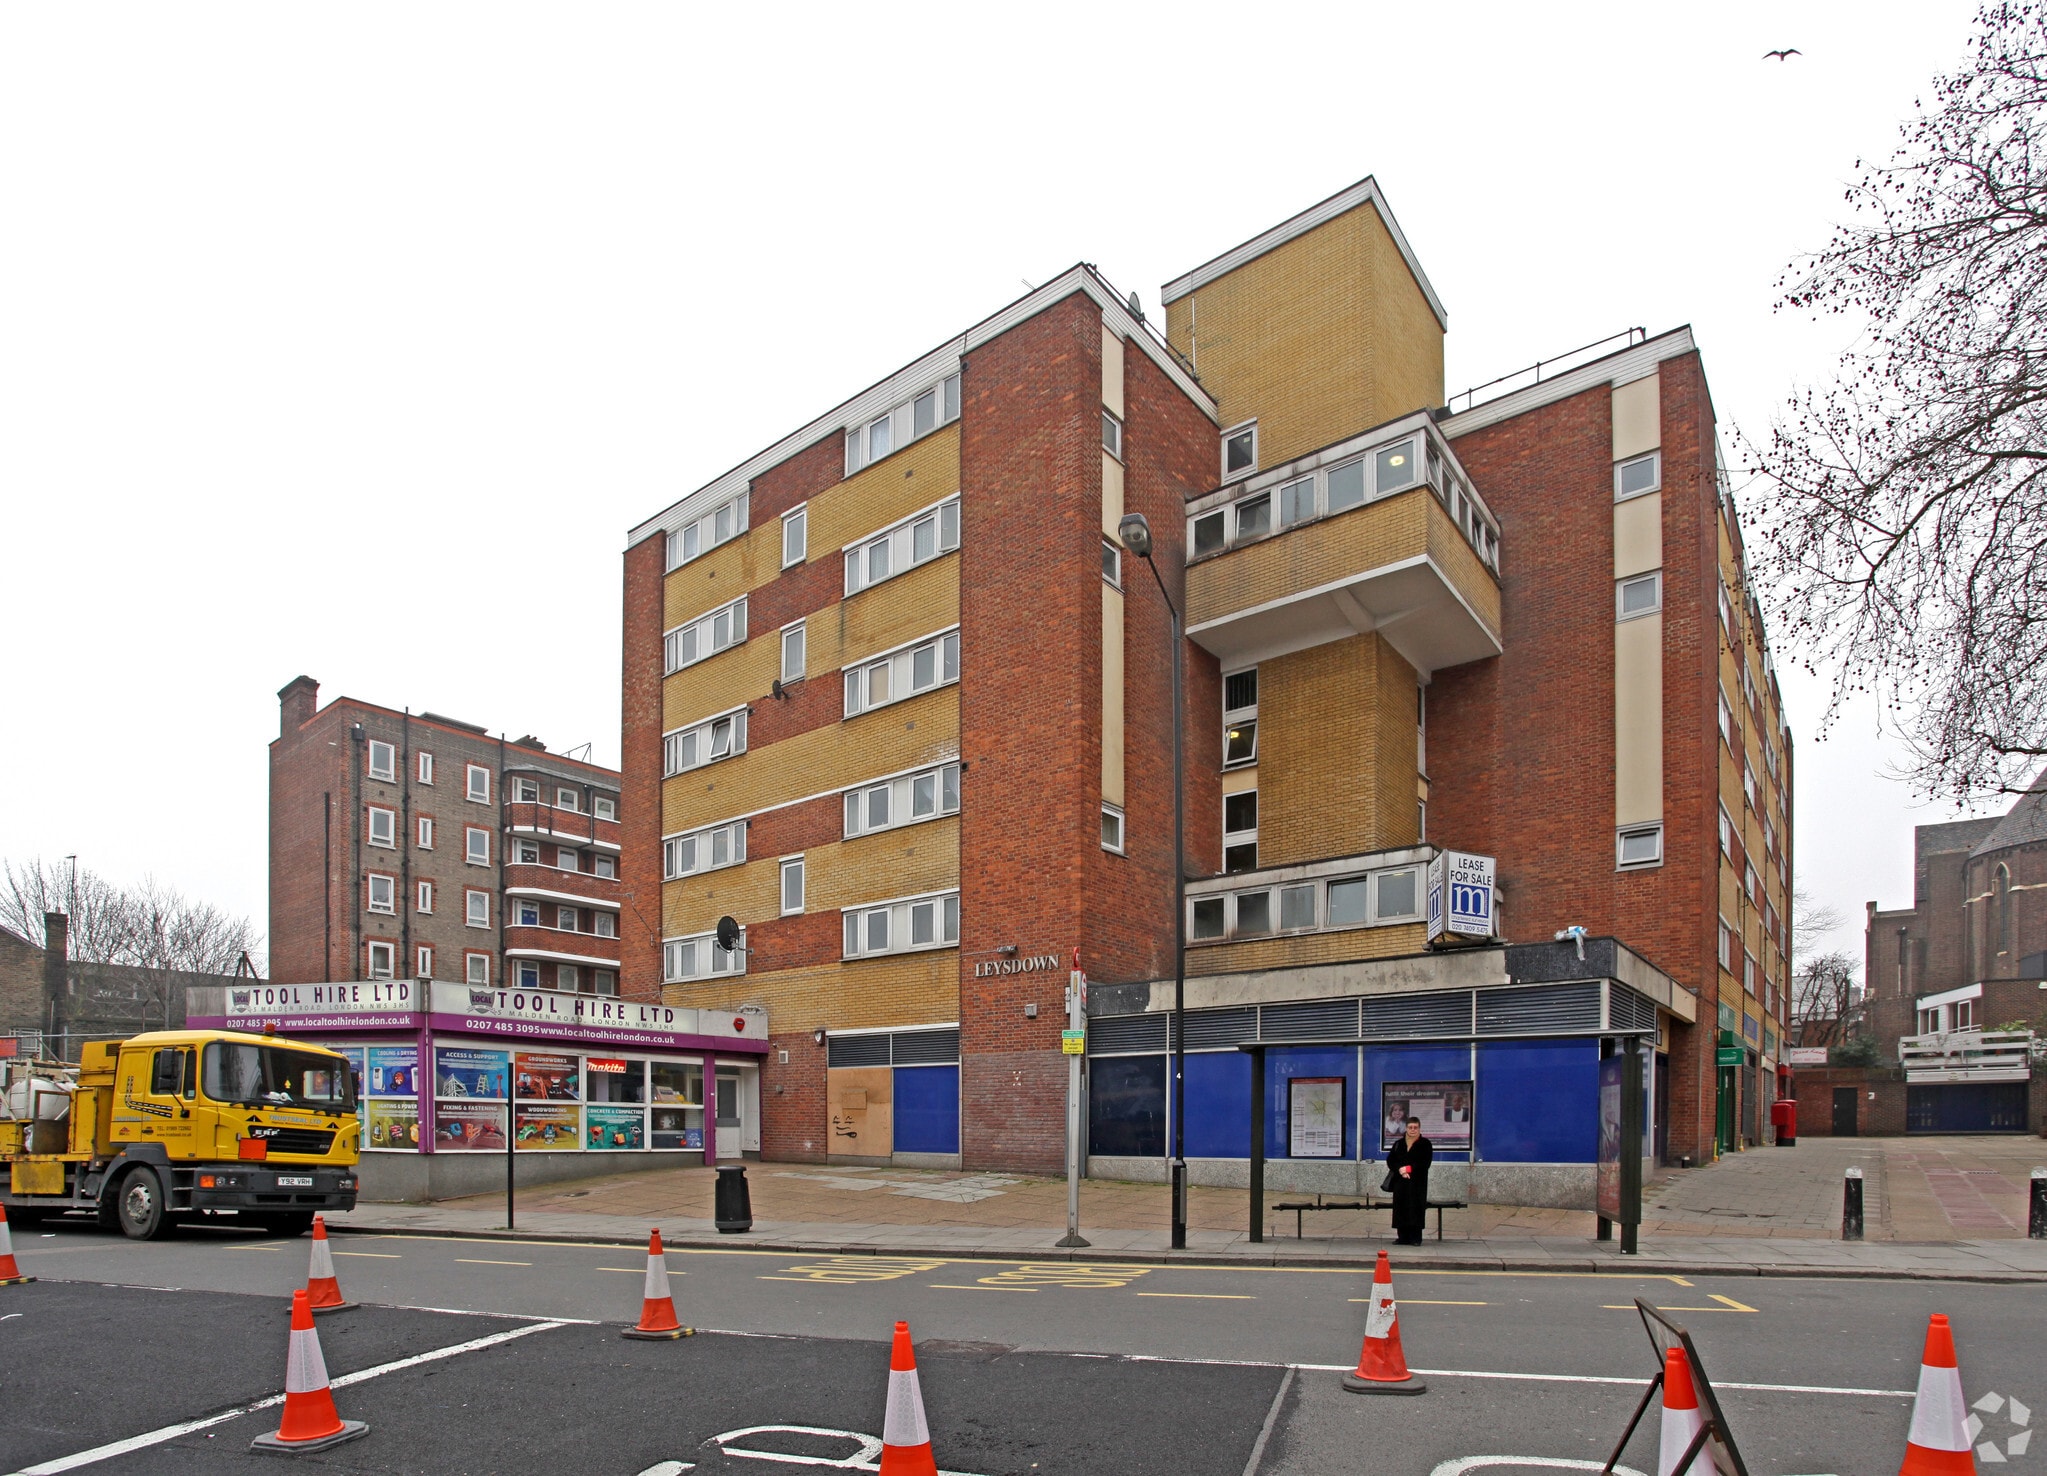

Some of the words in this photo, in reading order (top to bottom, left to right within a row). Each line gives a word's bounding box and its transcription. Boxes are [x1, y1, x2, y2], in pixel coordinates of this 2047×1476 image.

[1458, 858, 1484, 871] LEASE
[1450, 870, 1469, 882] FOR
[1471, 873, 1492, 886] SALE
[975, 955, 1060, 977] LEYSDOWN
[253, 987, 300, 1005] TOOL
[314, 985, 359, 1003] HIRE
[374, 983, 409, 1001] LTD
[471, 995, 492, 1004] LOCAL
[498, 992, 557, 1013] TOOL
[574, 1000, 625, 1019] HIRE
[640, 1006, 674, 1023] LTD
[226, 1019, 244, 1028] 0207
[246, 1019, 261, 1027] 485
[284, 1015, 411, 1027] www.localtoolhirelondon.co.uk
[509, 1010, 551, 1020] MALDEN
[592, 1018, 630, 1026] LONDON
[466, 1020, 492, 1029] 0207
[494, 1022, 513, 1031] 485
[516, 1024, 540, 1033] 3095
[540, 1028, 675, 1044] www.localtoolhirelondon.co.uk
[528, 1056, 567, 1064] GROUNDWORKS
